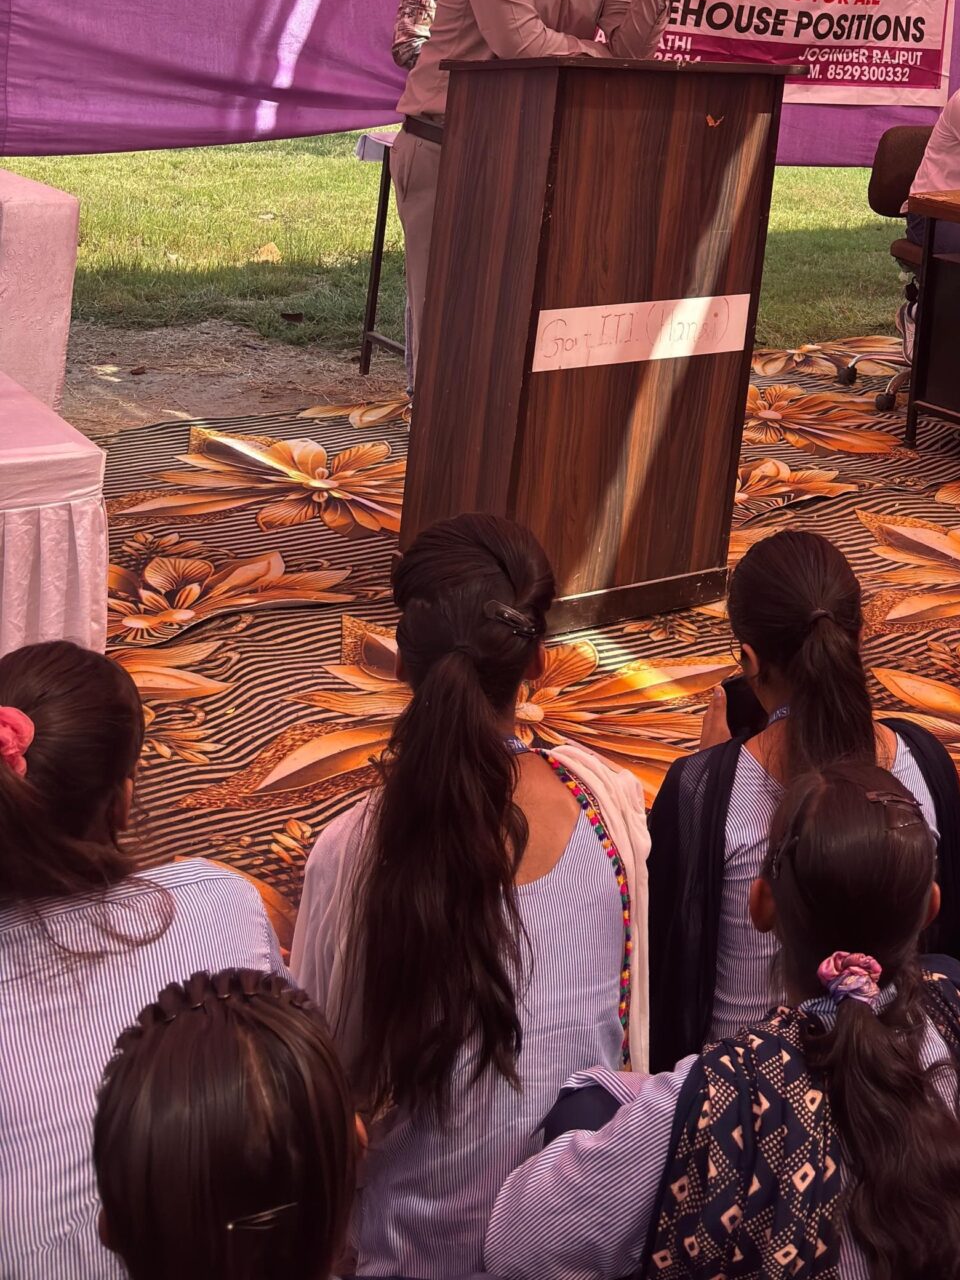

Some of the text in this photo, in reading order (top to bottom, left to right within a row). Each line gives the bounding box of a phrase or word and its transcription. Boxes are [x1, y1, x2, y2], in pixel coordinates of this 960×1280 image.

[793, 10, 926, 43] POSITIONS
[798, 47, 923, 66] JOGINDER RAJPUT
[826, 65, 910, 83] 8529300332
